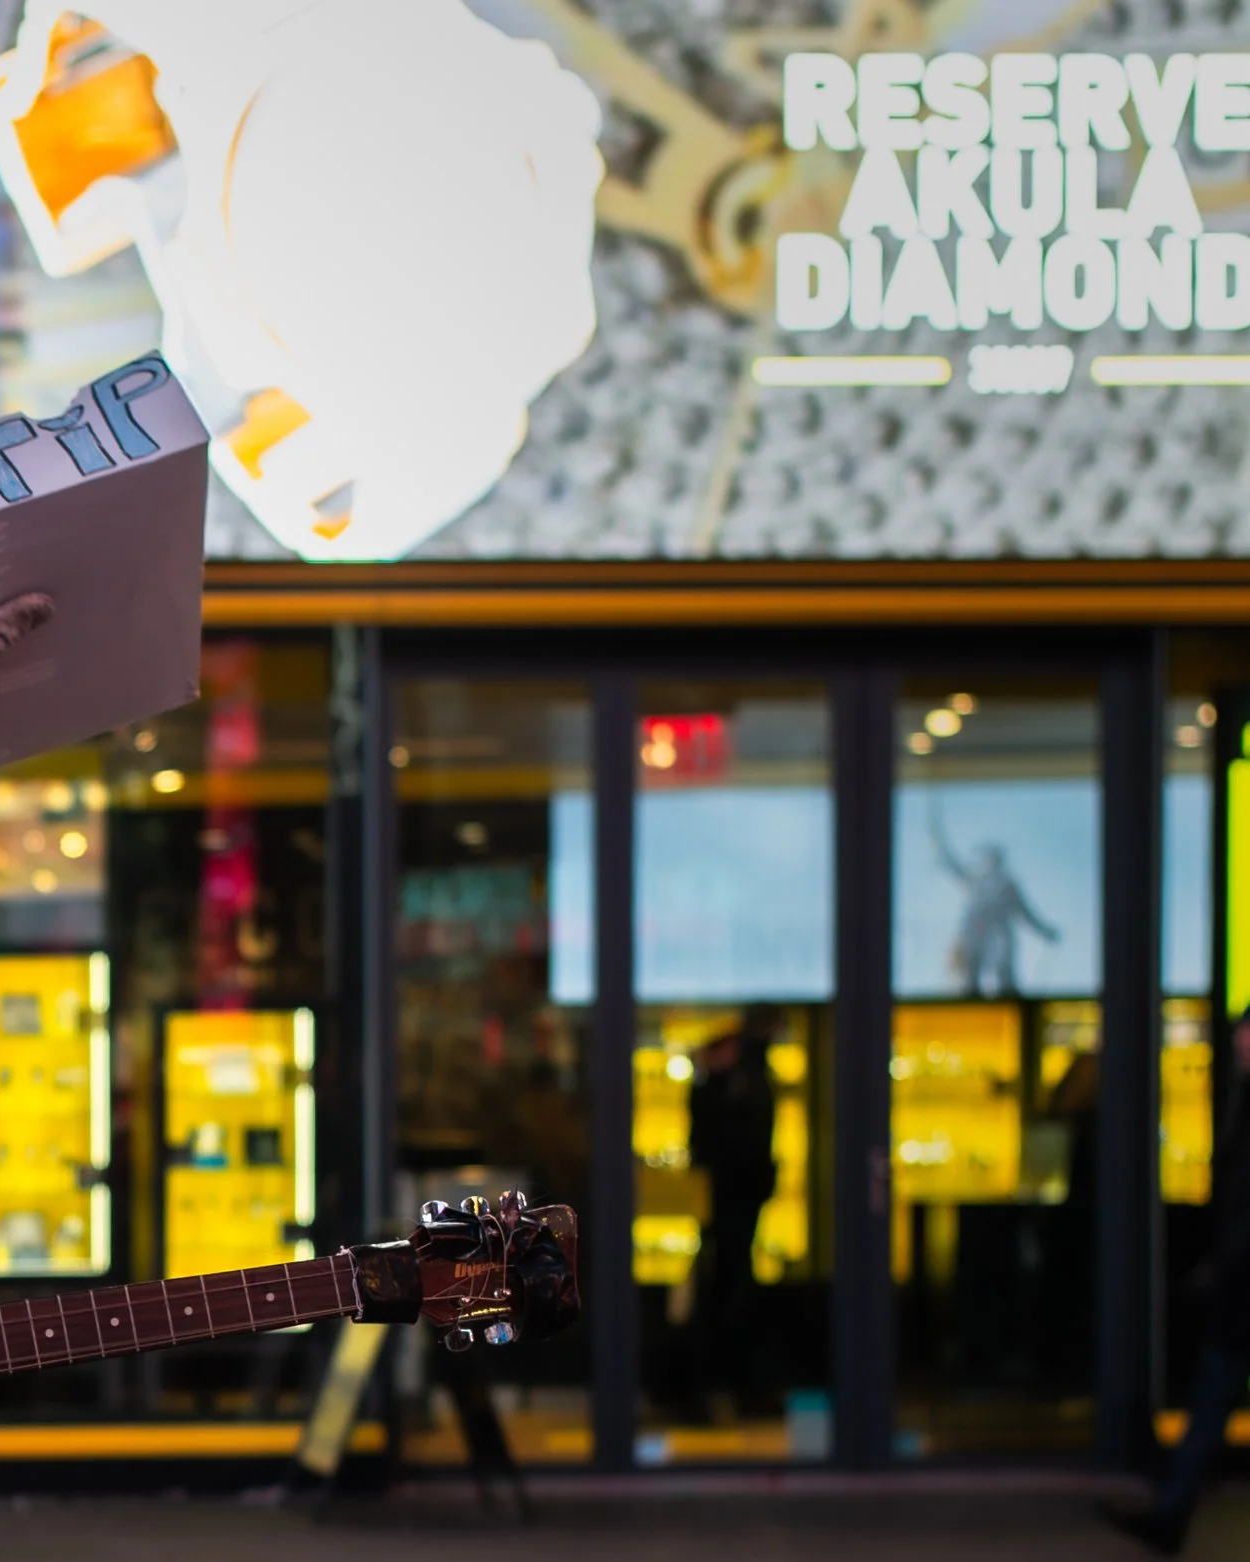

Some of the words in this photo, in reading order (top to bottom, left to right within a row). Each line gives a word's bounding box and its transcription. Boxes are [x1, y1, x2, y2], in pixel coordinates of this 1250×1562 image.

[783, 52, 1250, 150] RESERVE
[839, 143, 1203, 240] AKULA
[775, 232, 1250, 331] DIAMOND
